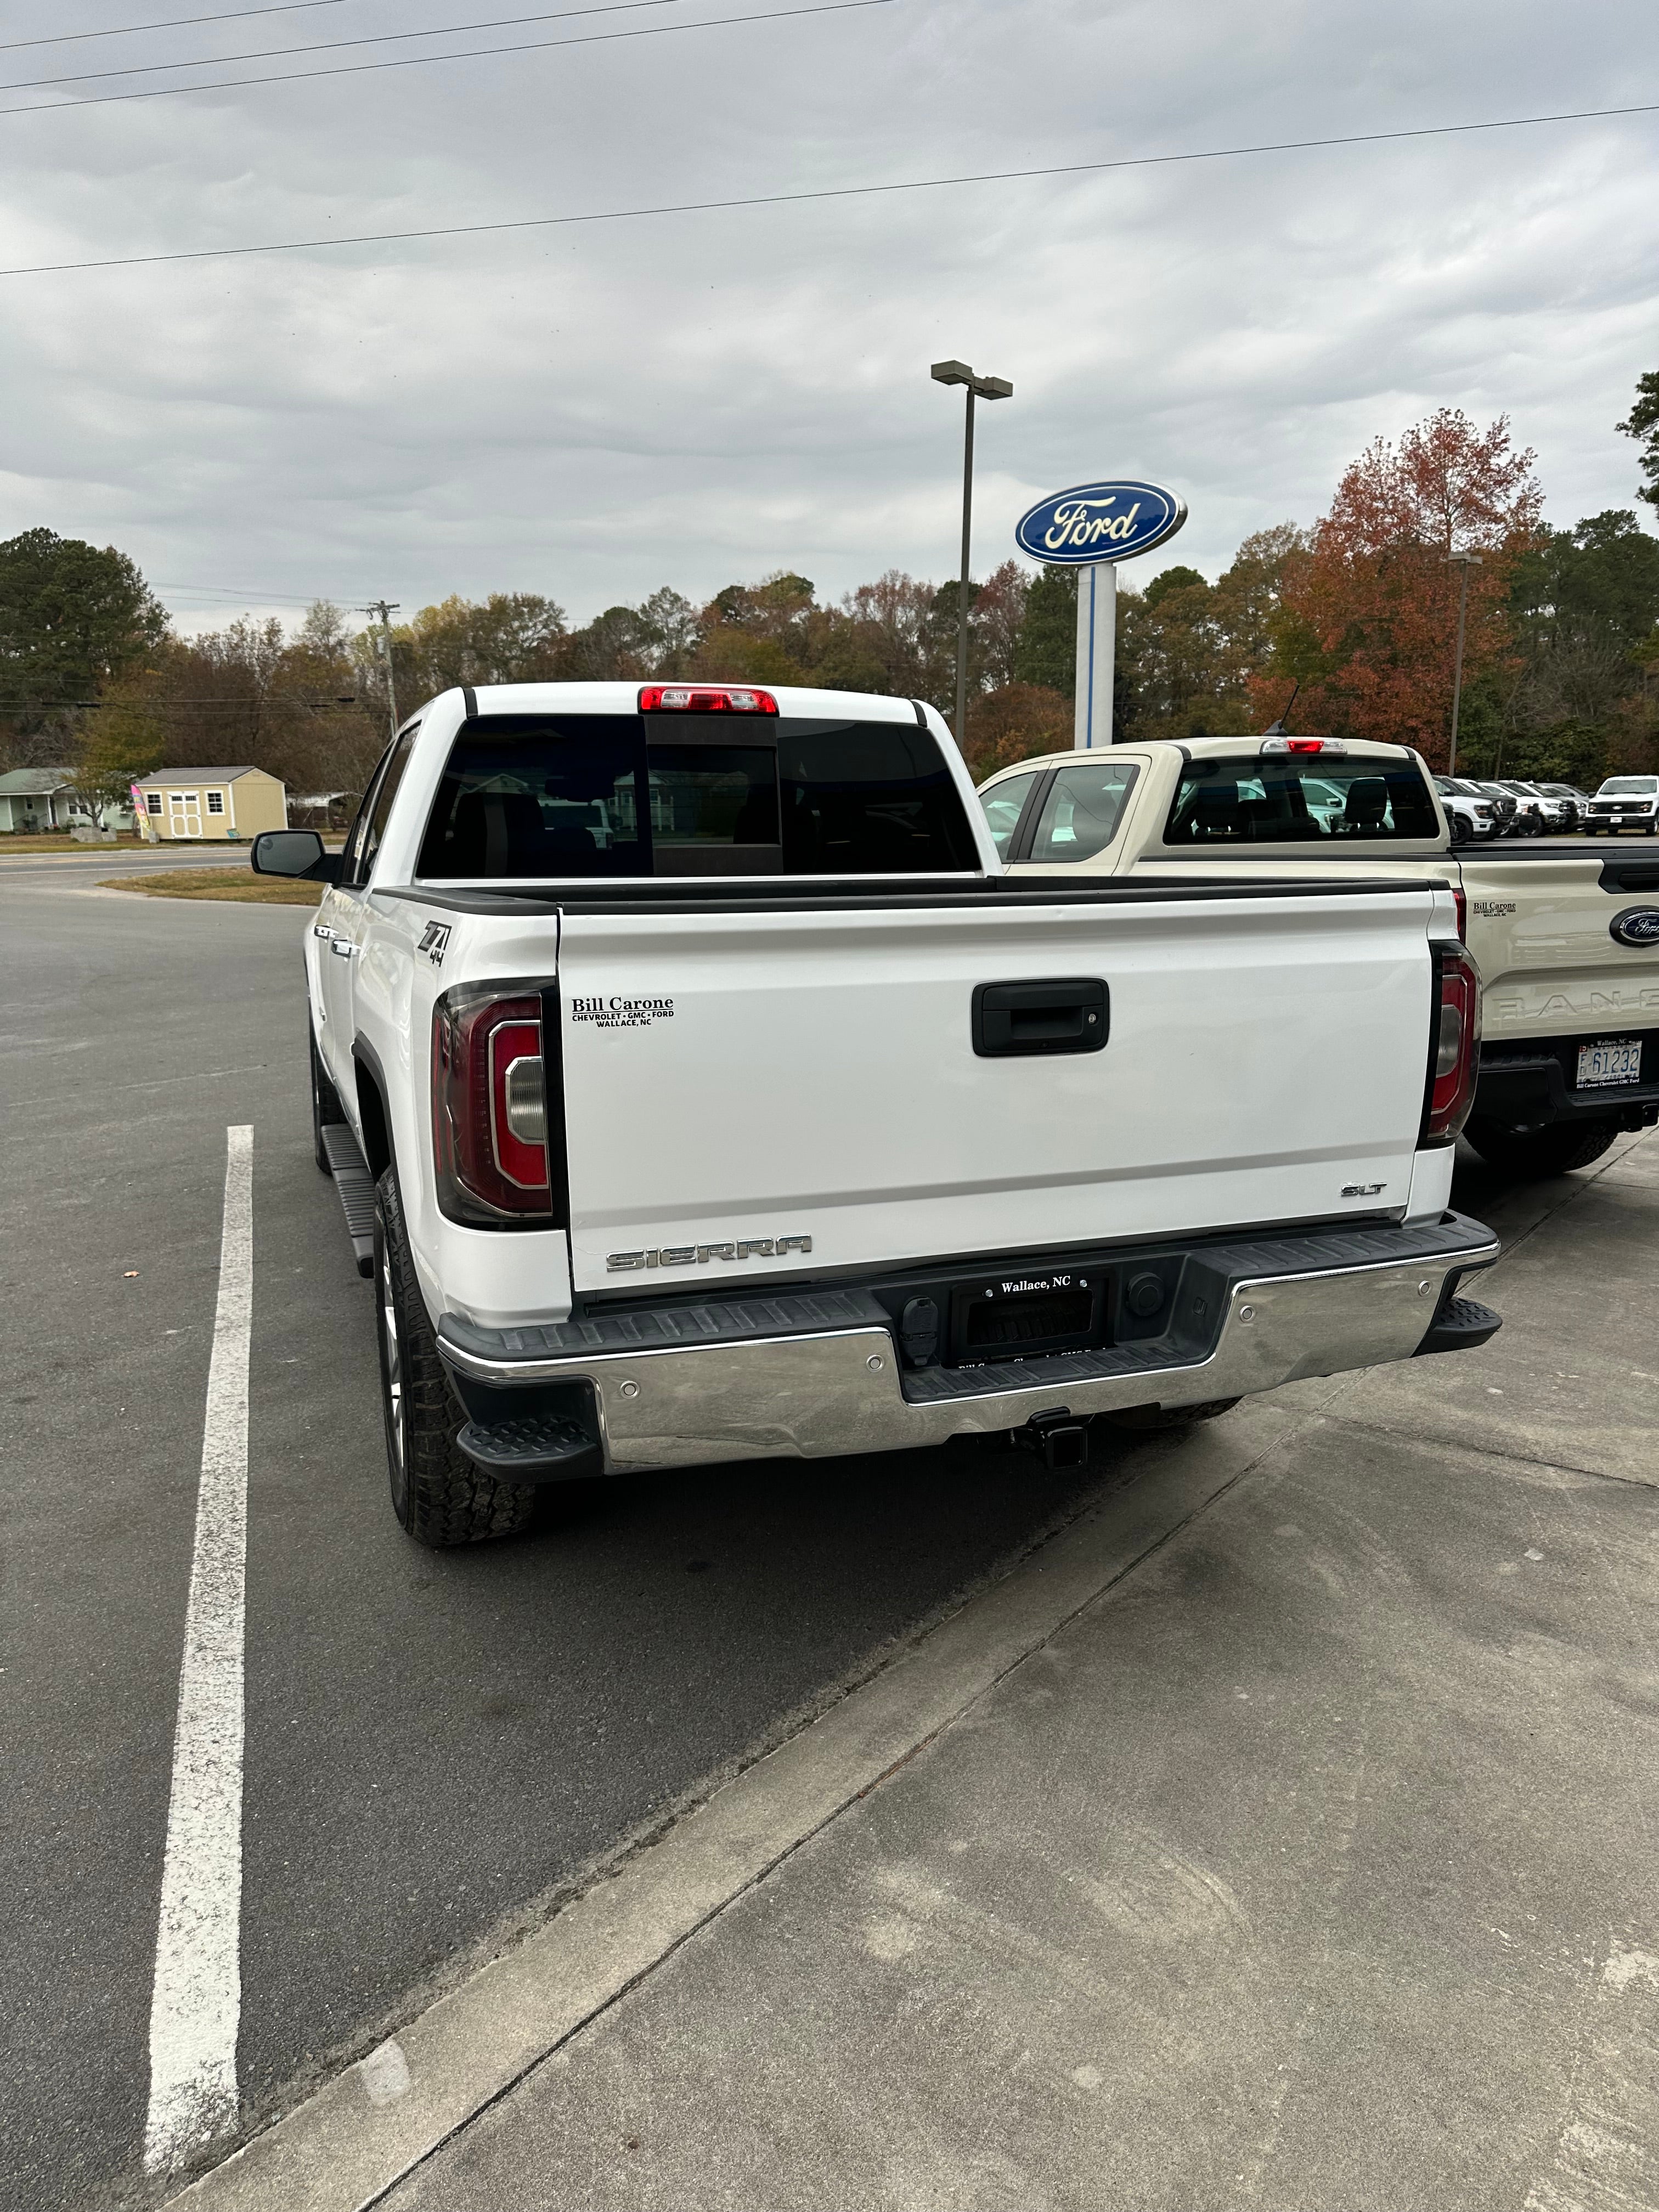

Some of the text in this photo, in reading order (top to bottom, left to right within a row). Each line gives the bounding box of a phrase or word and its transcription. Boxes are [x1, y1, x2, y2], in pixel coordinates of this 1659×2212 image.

[1045, 496, 1141, 549] Ford
[417, 920, 452, 952] Z71
[572, 996, 674, 1012] Bill Carone
[572, 1013, 621, 1022] CHEVROLET
[596, 1019, 639, 1028] WALLACE,
[1593, 1048, 1639, 1075] 61232
[1341, 1182, 1387, 1197] SLT
[606, 1233, 812, 1272] SIERRA
[1002, 1276, 1070, 1293] Wallace, NC
